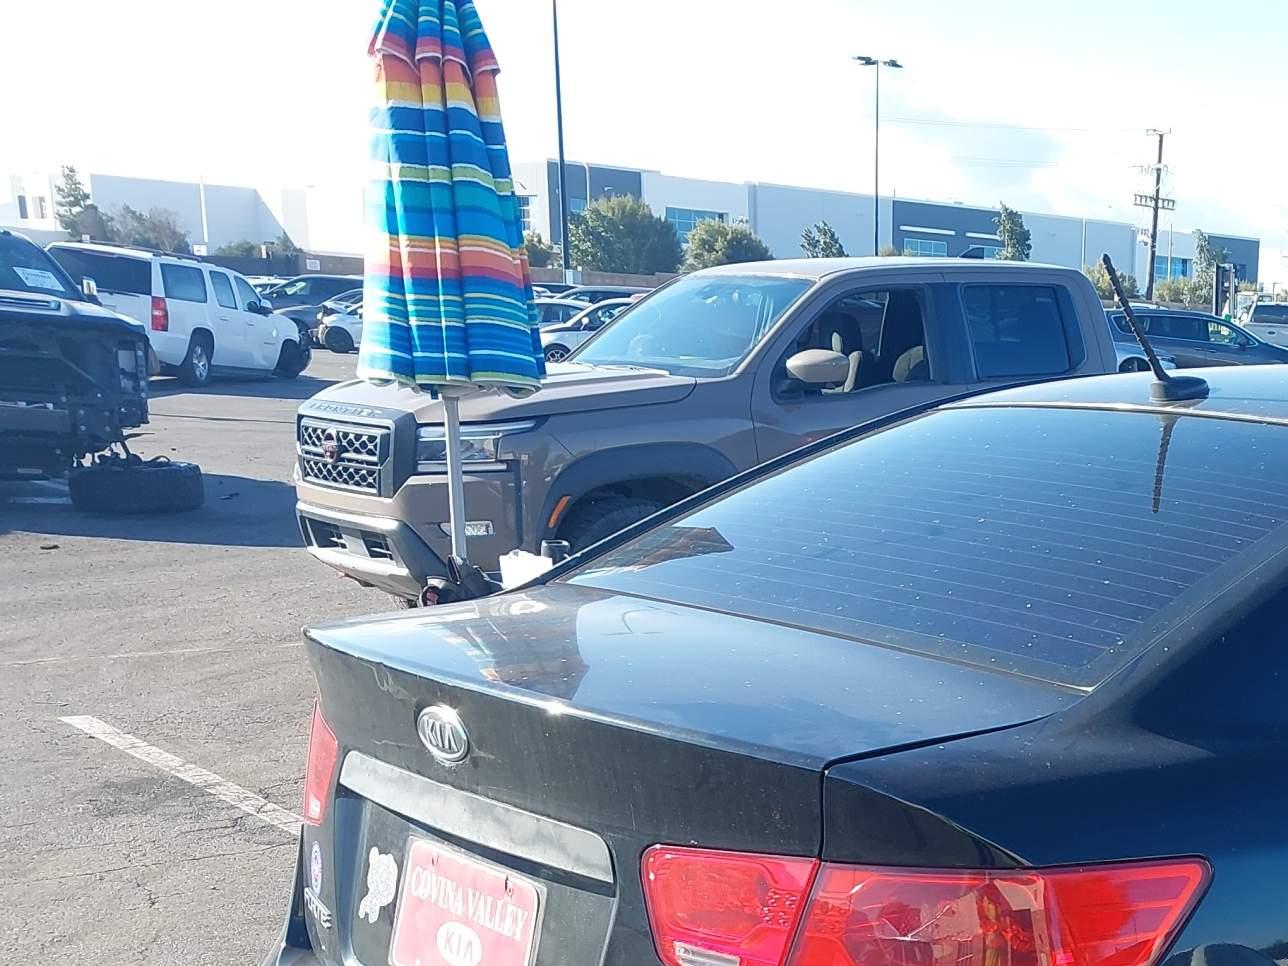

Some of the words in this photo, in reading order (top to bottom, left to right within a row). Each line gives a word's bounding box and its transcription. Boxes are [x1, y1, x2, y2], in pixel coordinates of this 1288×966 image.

[423, 715, 459, 752] KIA
[411, 866, 465, 917] COVINA
[466, 886, 528, 941] VALLEY
[444, 931, 473, 963] KIA
